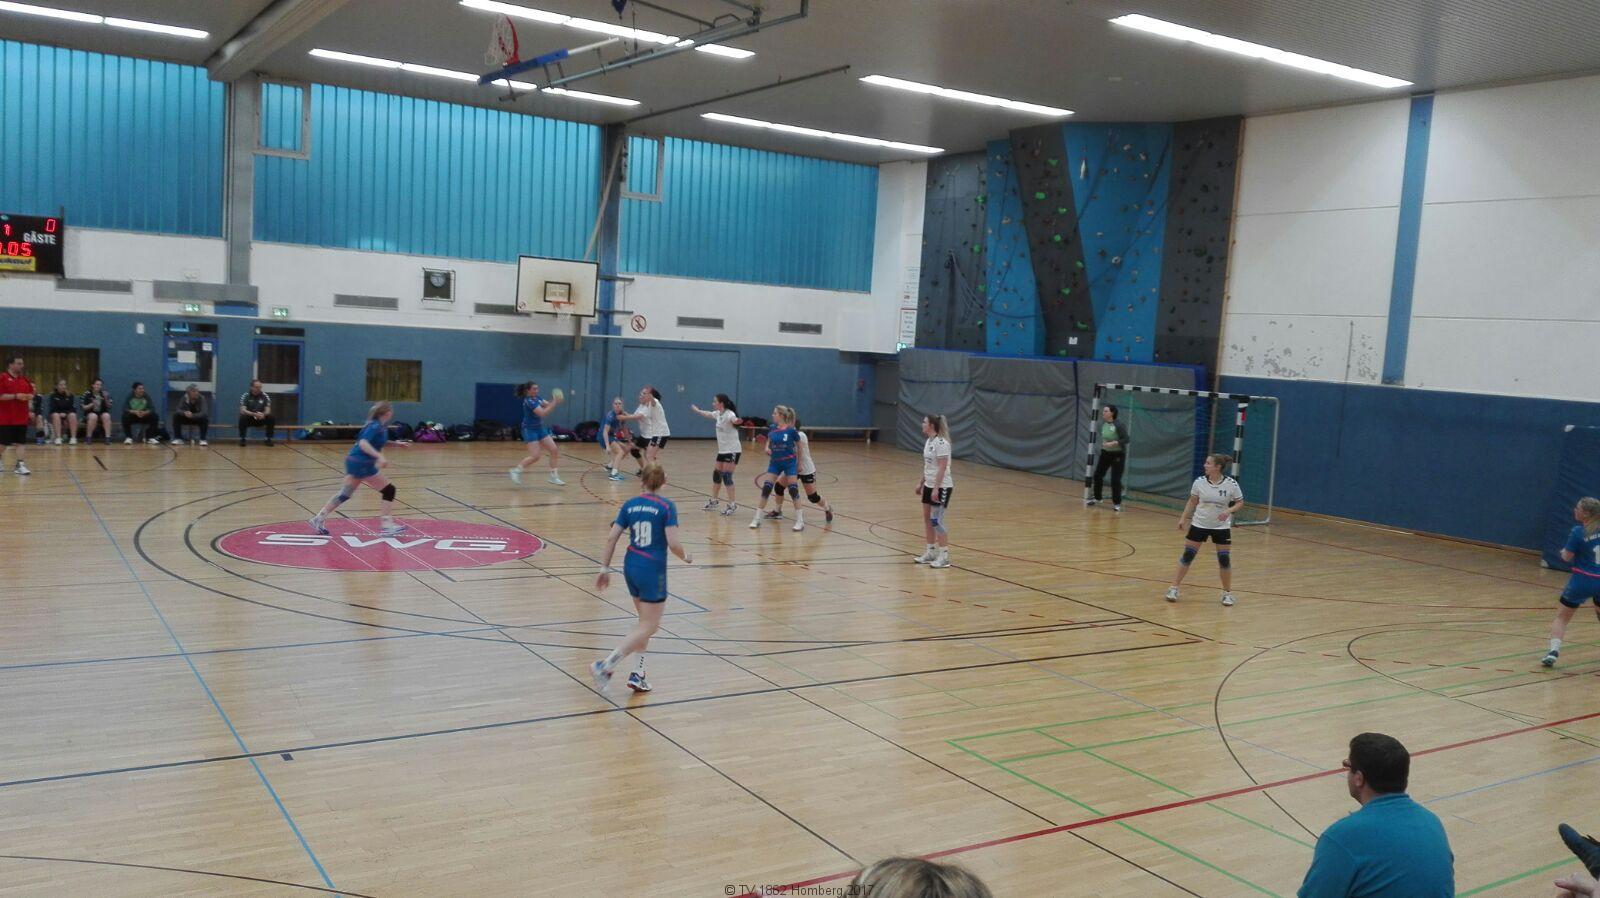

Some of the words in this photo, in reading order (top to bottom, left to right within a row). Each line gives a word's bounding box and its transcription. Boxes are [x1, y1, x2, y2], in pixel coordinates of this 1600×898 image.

[46, 218, 56, 232] 0
[23, 230, 56, 245] GÄSTE
[1218, 489, 1228, 497] 11
[632, 520, 653, 548] 19
[258, 533, 508, 552] SWG
